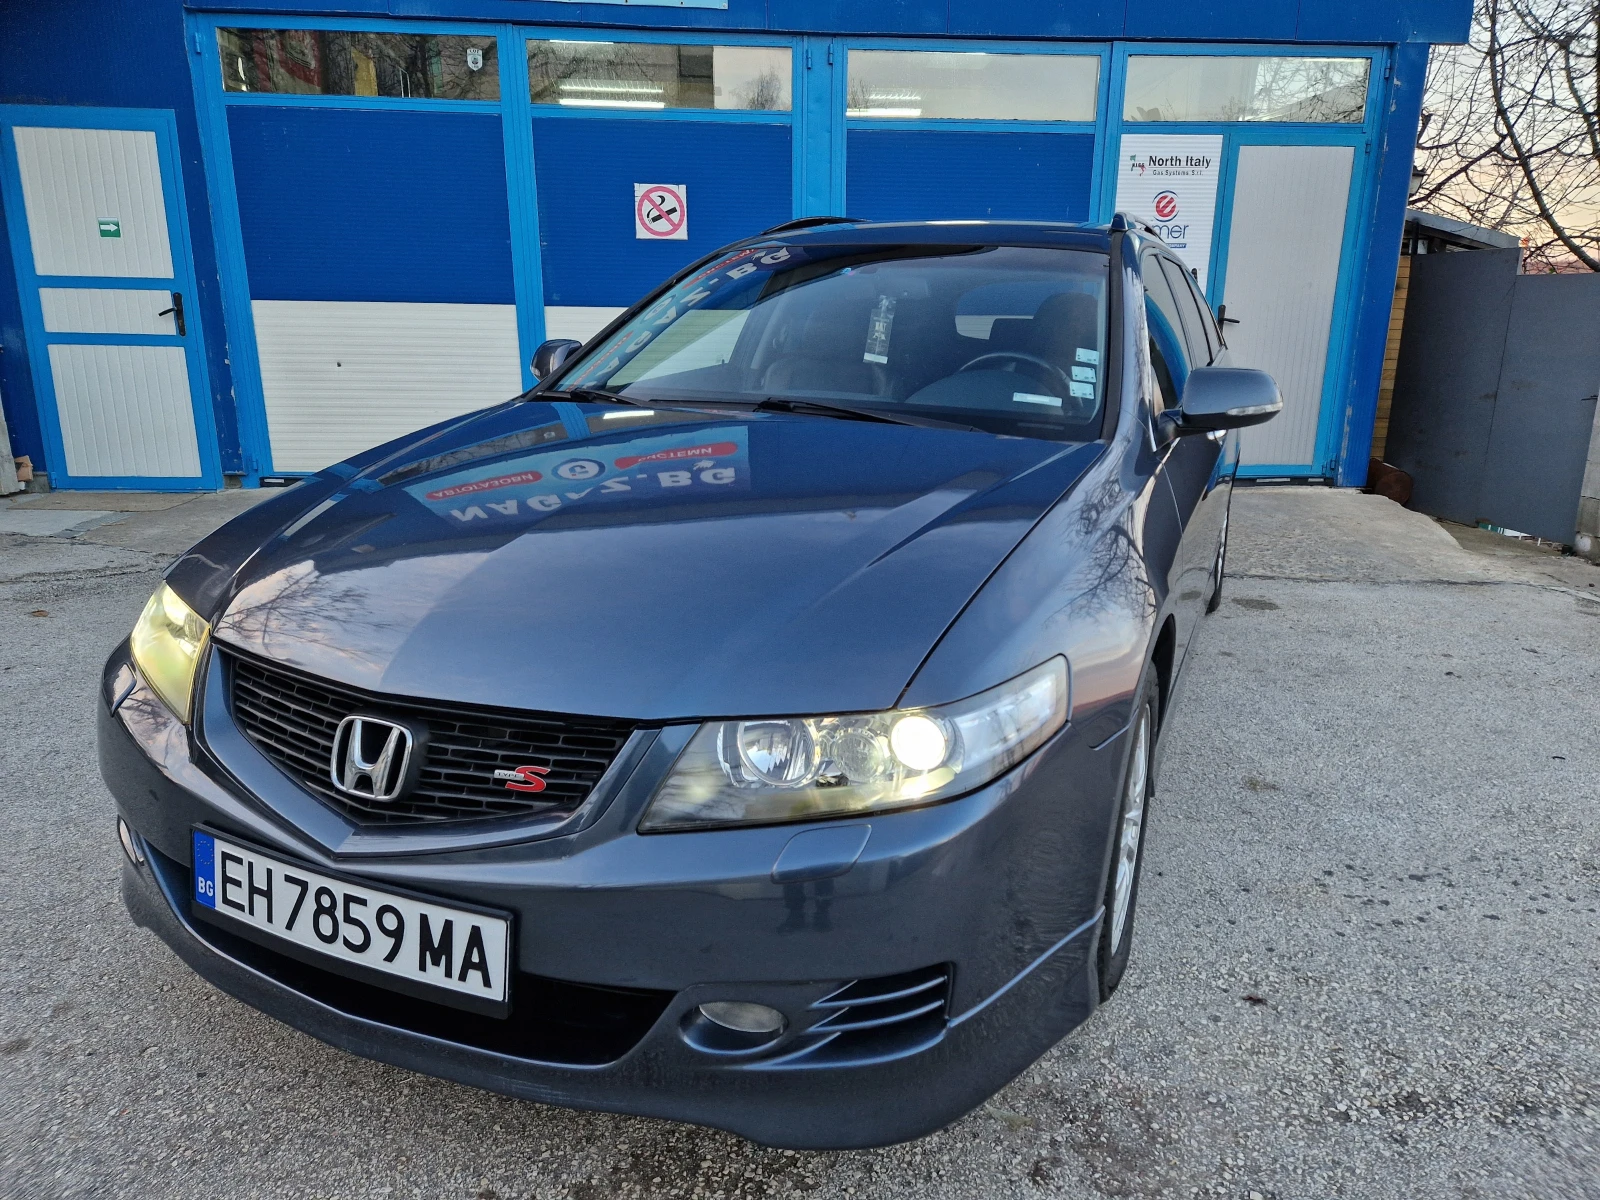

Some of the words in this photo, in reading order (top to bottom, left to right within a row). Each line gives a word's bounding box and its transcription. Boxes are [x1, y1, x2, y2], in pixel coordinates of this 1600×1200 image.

[1148, 155, 1182, 167] North
[1185, 155, 1212, 169] Italy
[1151, 224, 1190, 239] mer
[504, 765, 551, 793] S
[197, 876, 214, 897] BG
[220, 850, 274, 925] EH
[284, 873, 405, 963] 7859
[418, 912, 493, 989] MA
